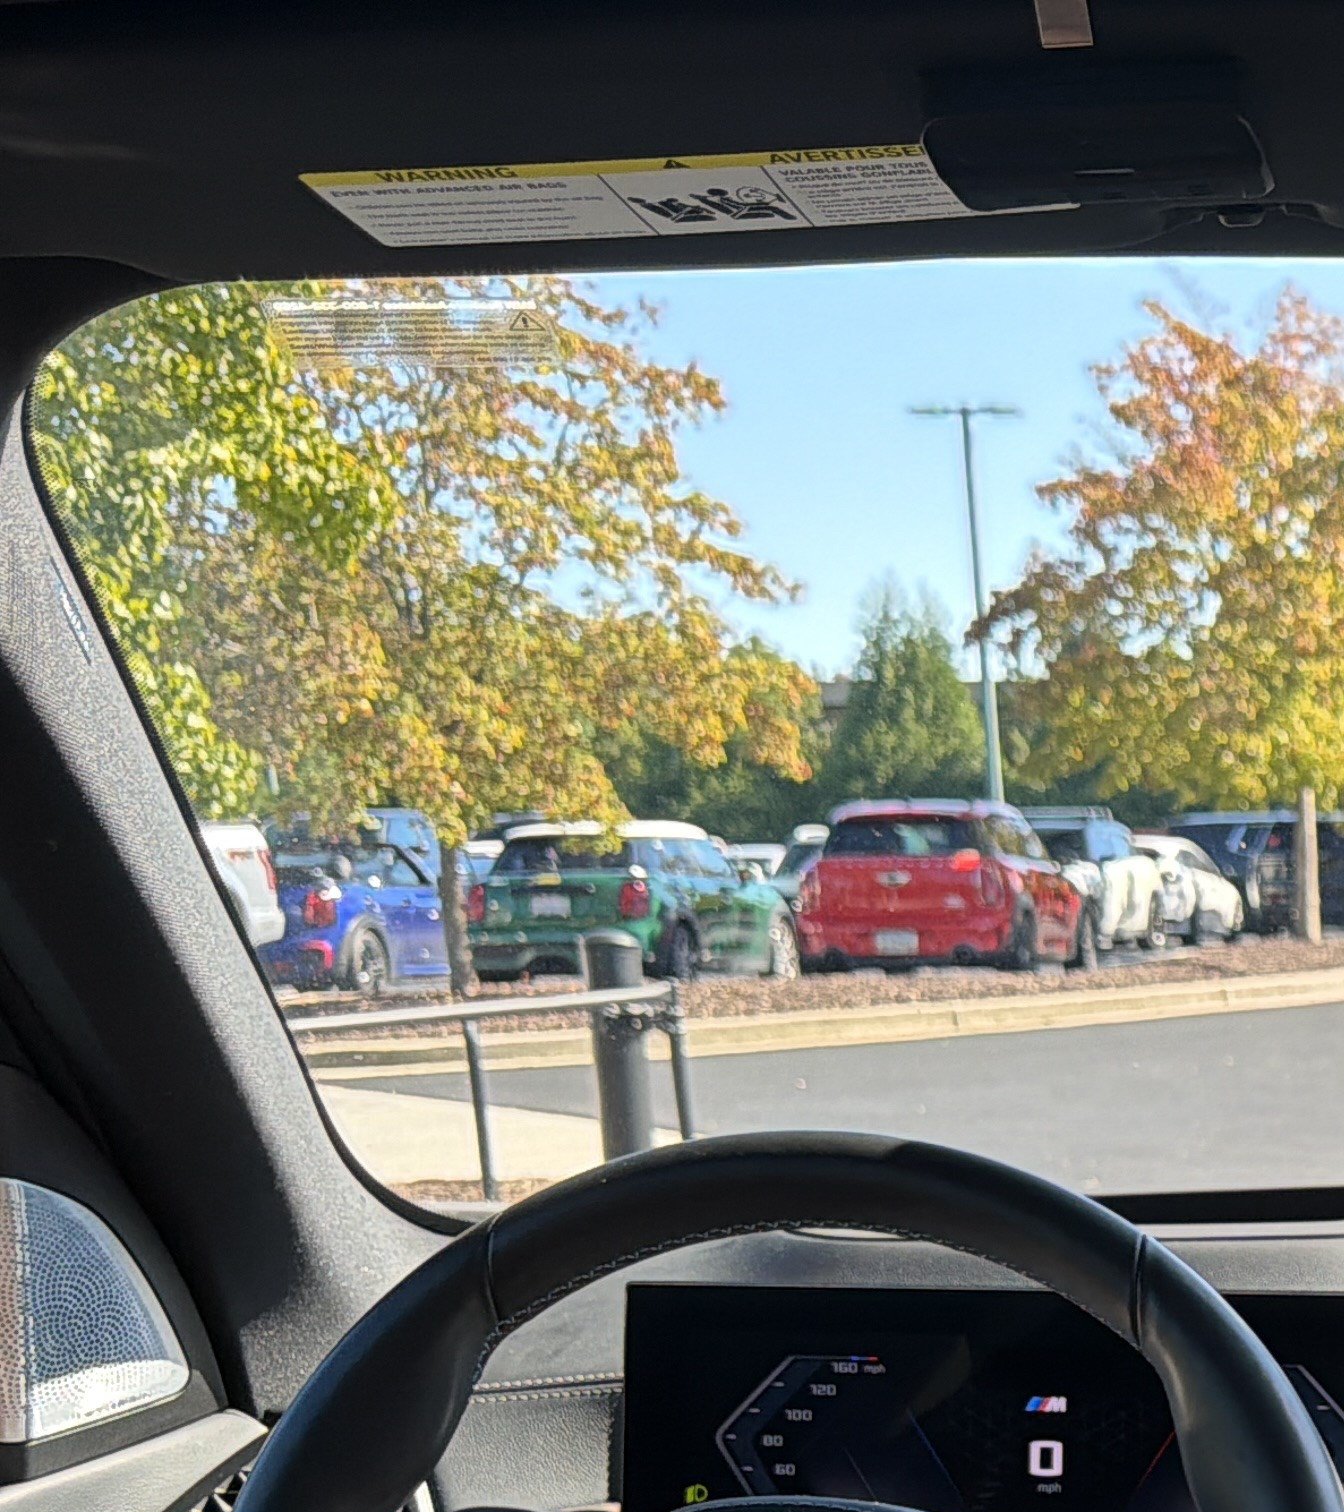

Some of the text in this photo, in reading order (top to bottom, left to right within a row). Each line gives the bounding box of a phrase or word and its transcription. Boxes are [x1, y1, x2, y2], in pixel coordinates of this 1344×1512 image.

[770, 146, 926, 164] AVERTISSE
[374, 167, 518, 183] WARNING
[831, 1362, 886, 1374] 160 mph
[809, 1384, 837, 1396] 120
[785, 1409, 813, 1421] 100
[762, 1434, 784, 1447] 80
[1028, 1440, 1063, 1477] 0
[774, 1463, 796, 1476] 60
[1037, 1482, 1062, 1494] mph
